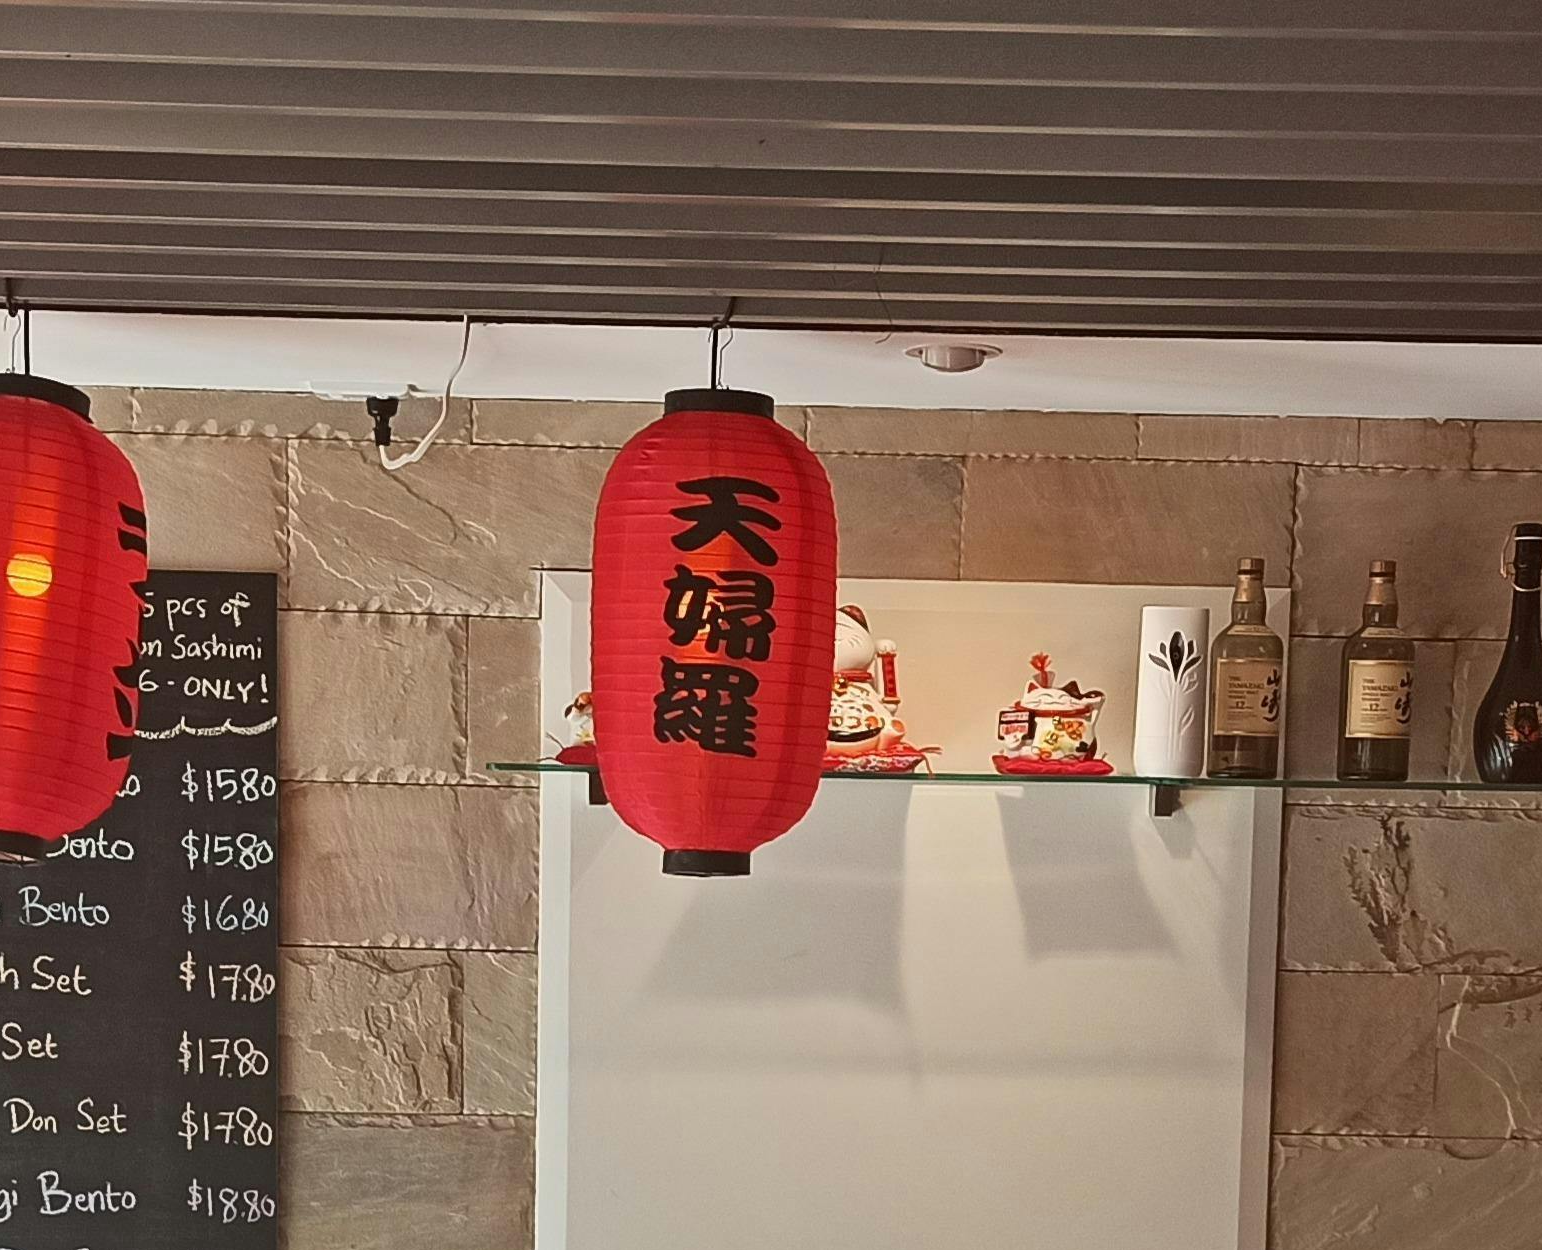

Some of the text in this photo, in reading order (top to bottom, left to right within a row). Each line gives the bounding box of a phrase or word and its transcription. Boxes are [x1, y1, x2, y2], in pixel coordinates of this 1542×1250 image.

[167, 598, 207, 631] pcs
[221, 592, 250, 627] of
[654, 476, 782, 758] 天婦羅
[171, 633, 261, 660] Sashimi
[184, 674, 268, 703] ONLY!
[181, 761, 276, 804] $15.80
[181, 829, 273, 870] $15.80
[18, 886, 109, 926] Bento
[182, 895, 268, 934] $16.80
[31, 956, 92, 995] Set
[2, 1022, 58, 1060] Set
[178, 1031, 269, 1078] $17.80
[3, 1098, 57, 1133] Don
[77, 1097, 126, 1133] Set
[178, 1102, 272, 1150] $17.80
[37, 1170, 136, 1215] Bento
[188, 1178, 275, 1223] $18.80
